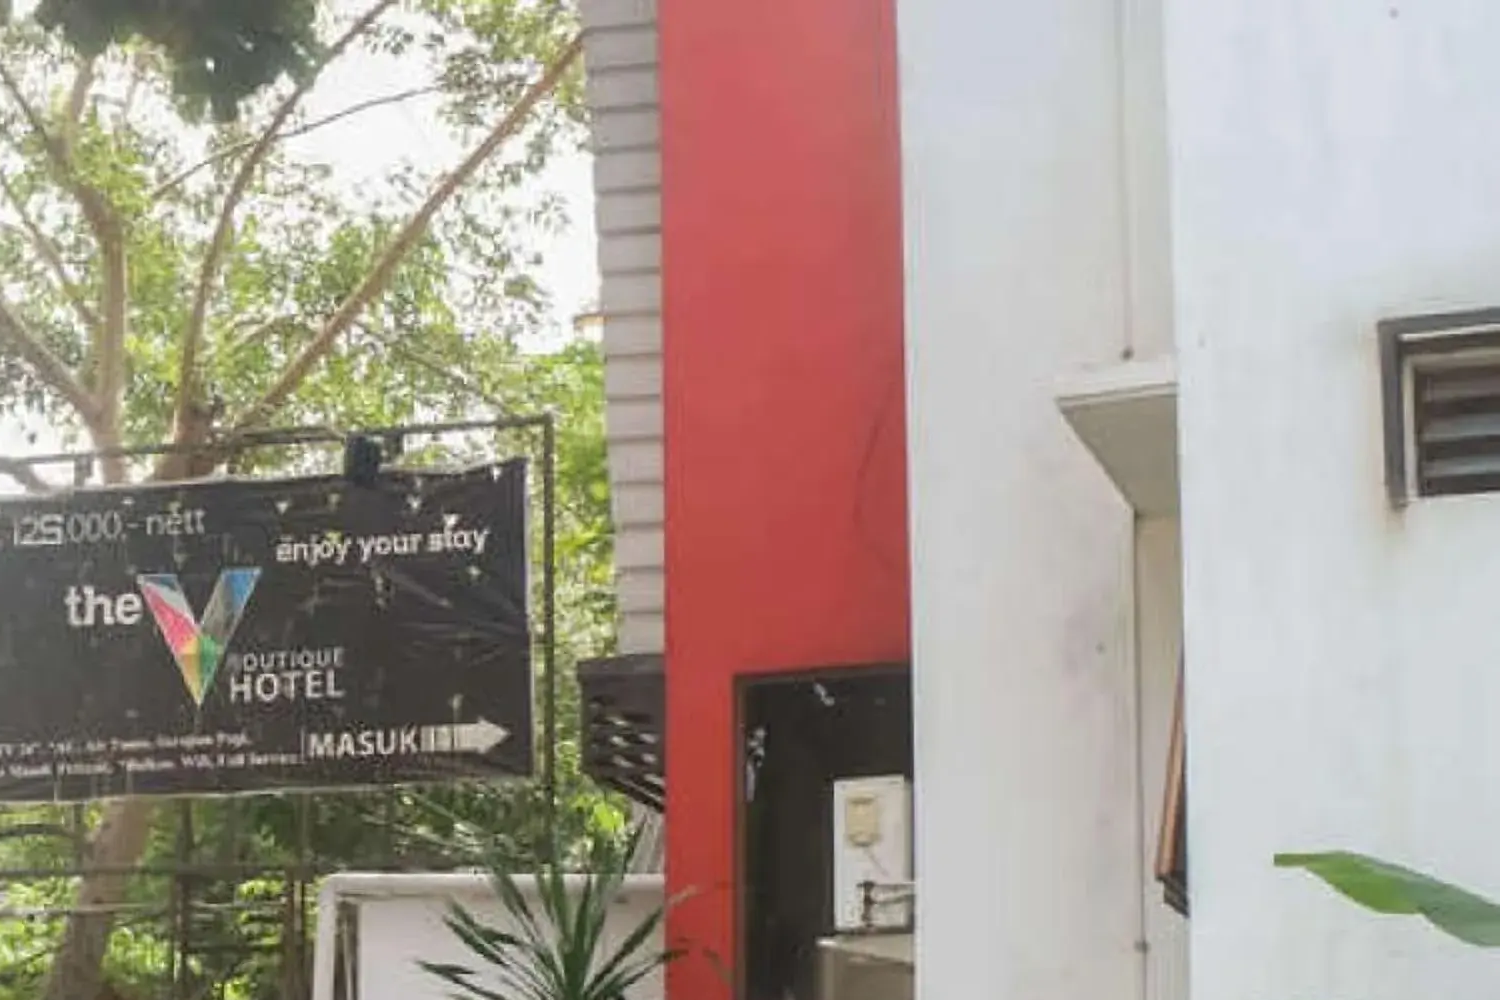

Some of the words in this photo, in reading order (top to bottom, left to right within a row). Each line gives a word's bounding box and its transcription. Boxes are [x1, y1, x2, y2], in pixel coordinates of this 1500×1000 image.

[276, 533, 350, 566] enjoy
[357, 533, 422, 562] your
[427, 515, 489, 554] stay
[64, 586, 143, 627] the
[137, 566, 263, 705] V
[229, 670, 346, 702] HOTEL
[308, 725, 418, 758] MASUK
